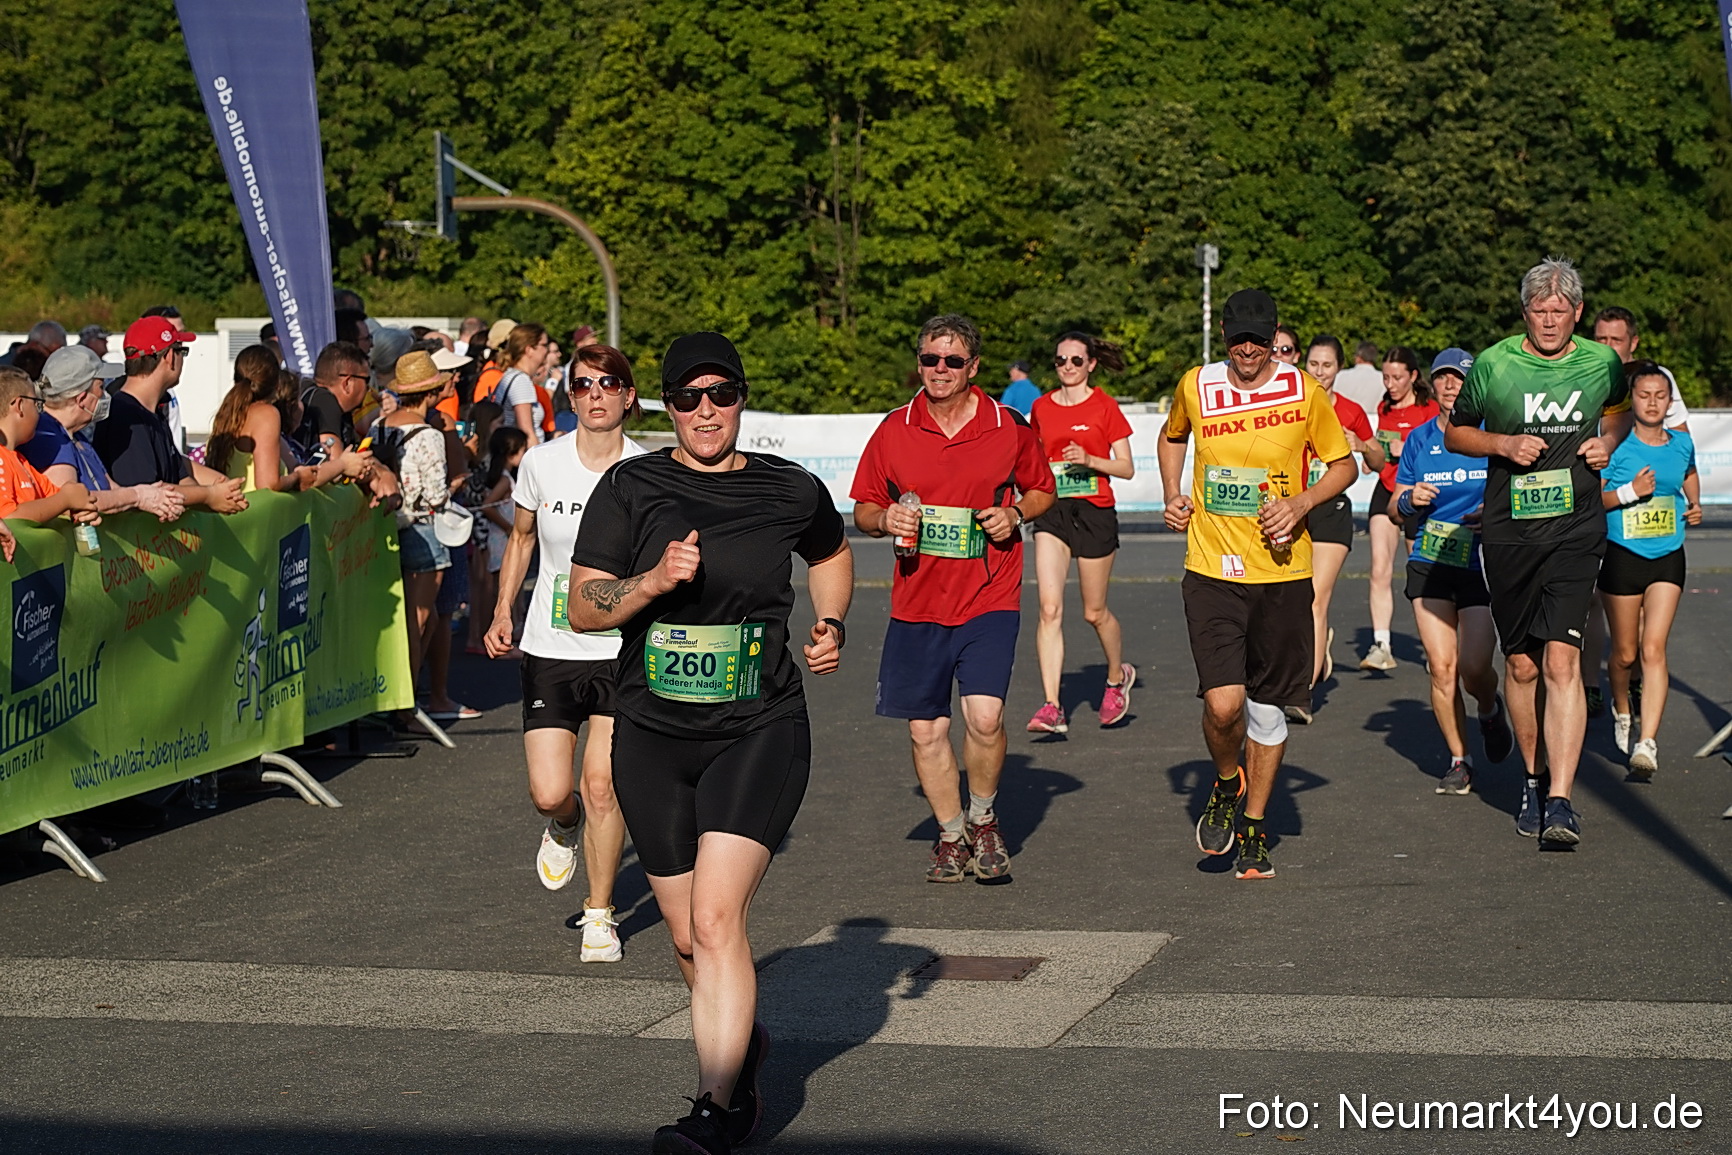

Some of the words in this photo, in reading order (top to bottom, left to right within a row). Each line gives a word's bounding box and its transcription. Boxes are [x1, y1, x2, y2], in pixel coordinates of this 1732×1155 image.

[1202, 419, 1247, 438] MAX
[1254, 409, 1306, 430] BÖGL
[1524, 426, 1539, 434] KW
[1423, 472, 1452, 482] SCHICK
[1217, 483, 1251, 501] 992
[1520, 486, 1564, 504] 1872
[1563, 487, 1571, 508] 2022
[1520, 503, 1545, 511] Englisch
[1633, 510, 1668, 525] 1347
[959, 528, 967, 551] 2022
[1431, 534, 1457, 552] 732
[100, 533, 154, 592] Gesunde
[152, 523, 200, 568] Firmen
[124, 582, 163, 632] laufen
[165, 555, 206, 616] länger!
[24, 603, 55, 632] Fischer
[648, 654, 657, 680] RUN
[664, 651, 717, 677] 260
[725, 655, 736, 691] 2022
[659, 675, 694, 687] Federer
[696, 680, 722, 689] Nadja
[71, 722, 210, 790] www.firmenlauf-oberpfalz.de
